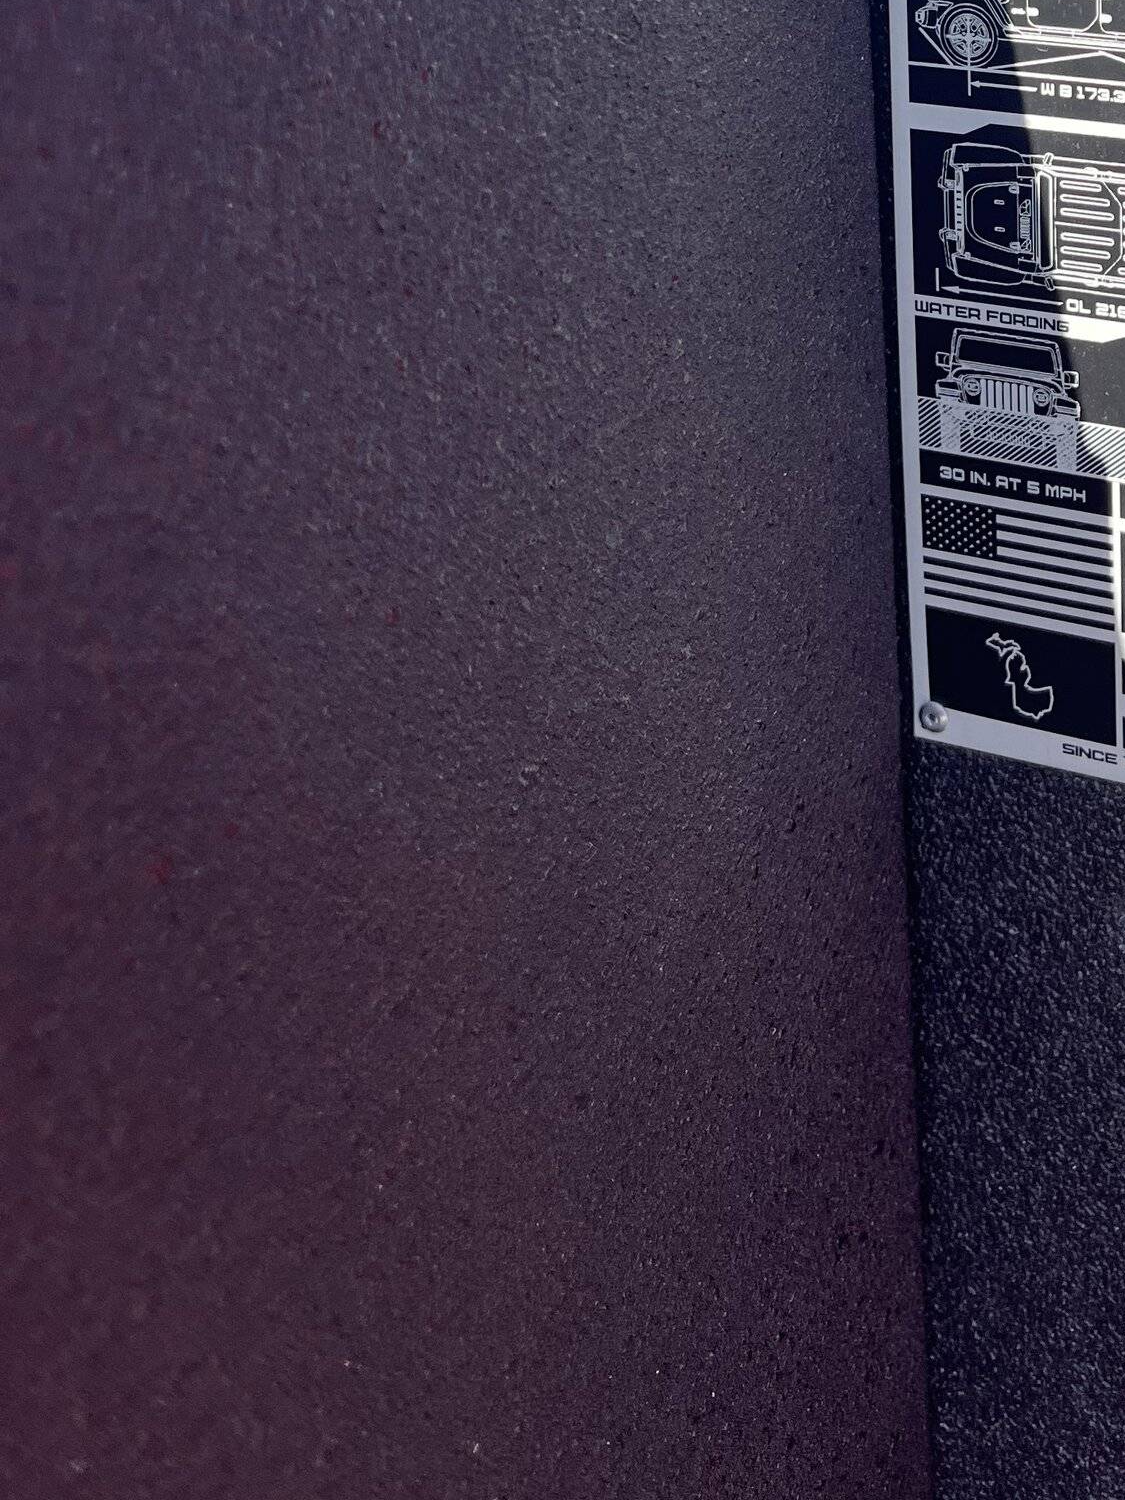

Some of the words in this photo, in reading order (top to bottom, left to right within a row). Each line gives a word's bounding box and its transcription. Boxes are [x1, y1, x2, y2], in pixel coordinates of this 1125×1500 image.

[914, 299, 981, 320] WATER
[986, 310, 1069, 333] FORDING
[939, 465, 965, 482] 30
[969, 470, 991, 486] IN.
[995, 475, 1021, 492] AT
[1026, 480, 1040, 495] 5
[1045, 483, 1086, 503] MPH
[1062, 743, 1118, 765] SINCE
